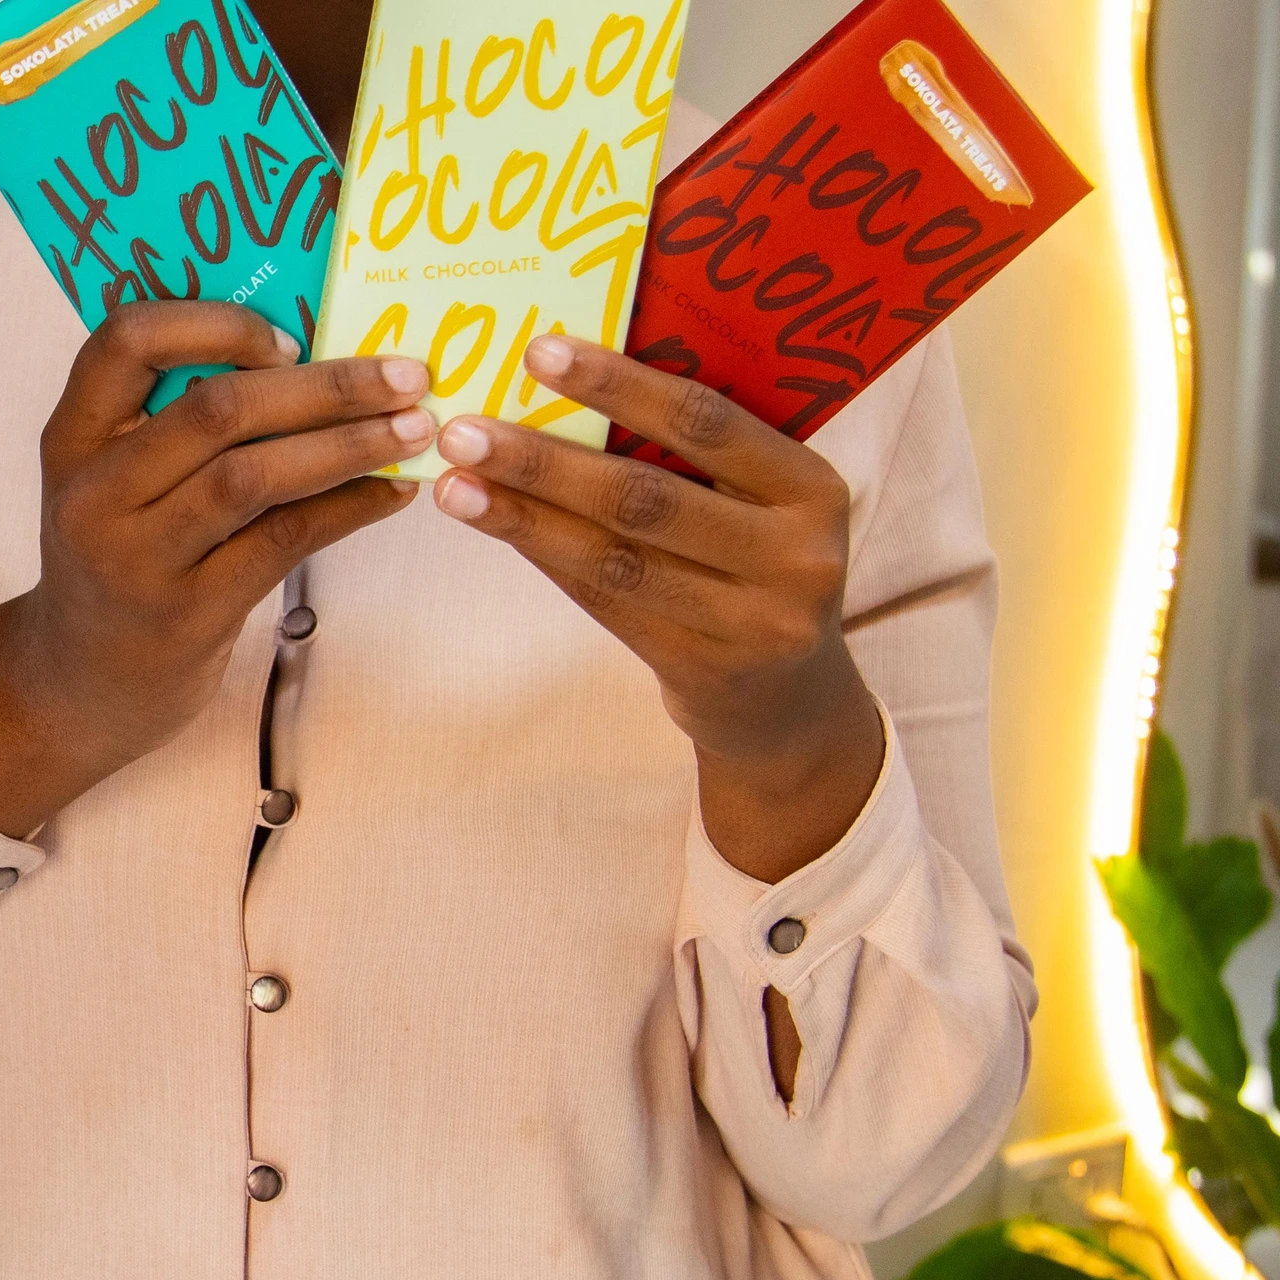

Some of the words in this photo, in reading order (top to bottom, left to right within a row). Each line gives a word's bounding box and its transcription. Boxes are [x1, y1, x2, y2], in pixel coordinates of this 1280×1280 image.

[0, 24, 88, 87] SOKOLATA
[899, 62, 964, 141] SOKOLATA
[959, 133, 1008, 193] TREATS
[226, 260, 279, 304] OLATE
[364, 266, 409, 284] MILK
[423, 255, 541, 280] CHOCOLATE
[641, 269, 674, 297] ARK
[674, 291, 766, 362] CHOCOLATE
